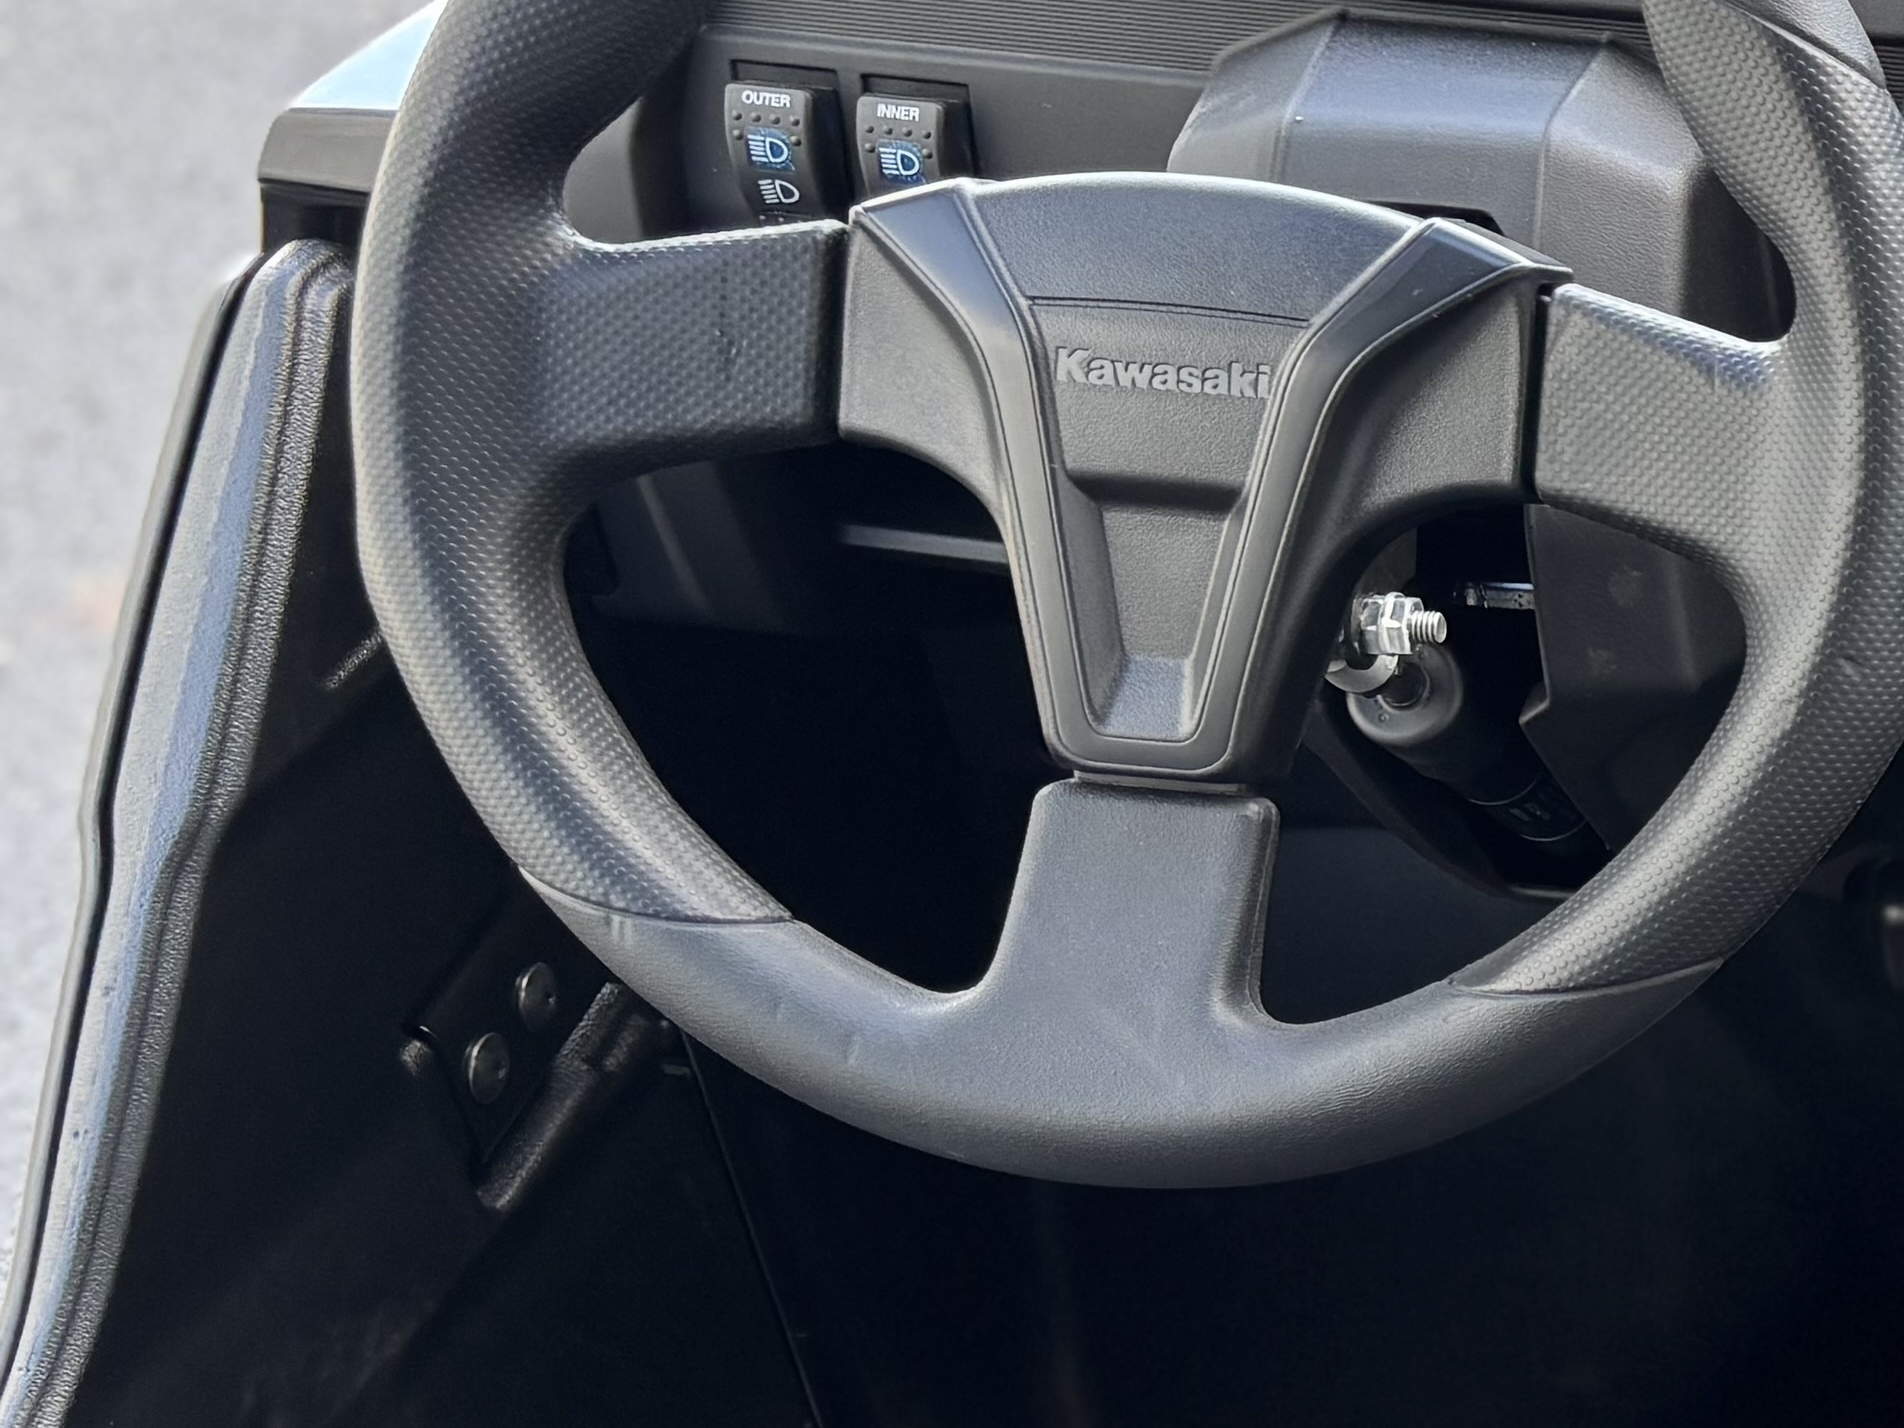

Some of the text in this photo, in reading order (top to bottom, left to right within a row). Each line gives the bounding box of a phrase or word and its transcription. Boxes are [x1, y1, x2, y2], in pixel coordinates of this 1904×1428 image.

[741, 89, 791, 109] OUTER
[876, 103, 920, 123] INNER
[1055, 346, 1271, 399] Kawasaki
